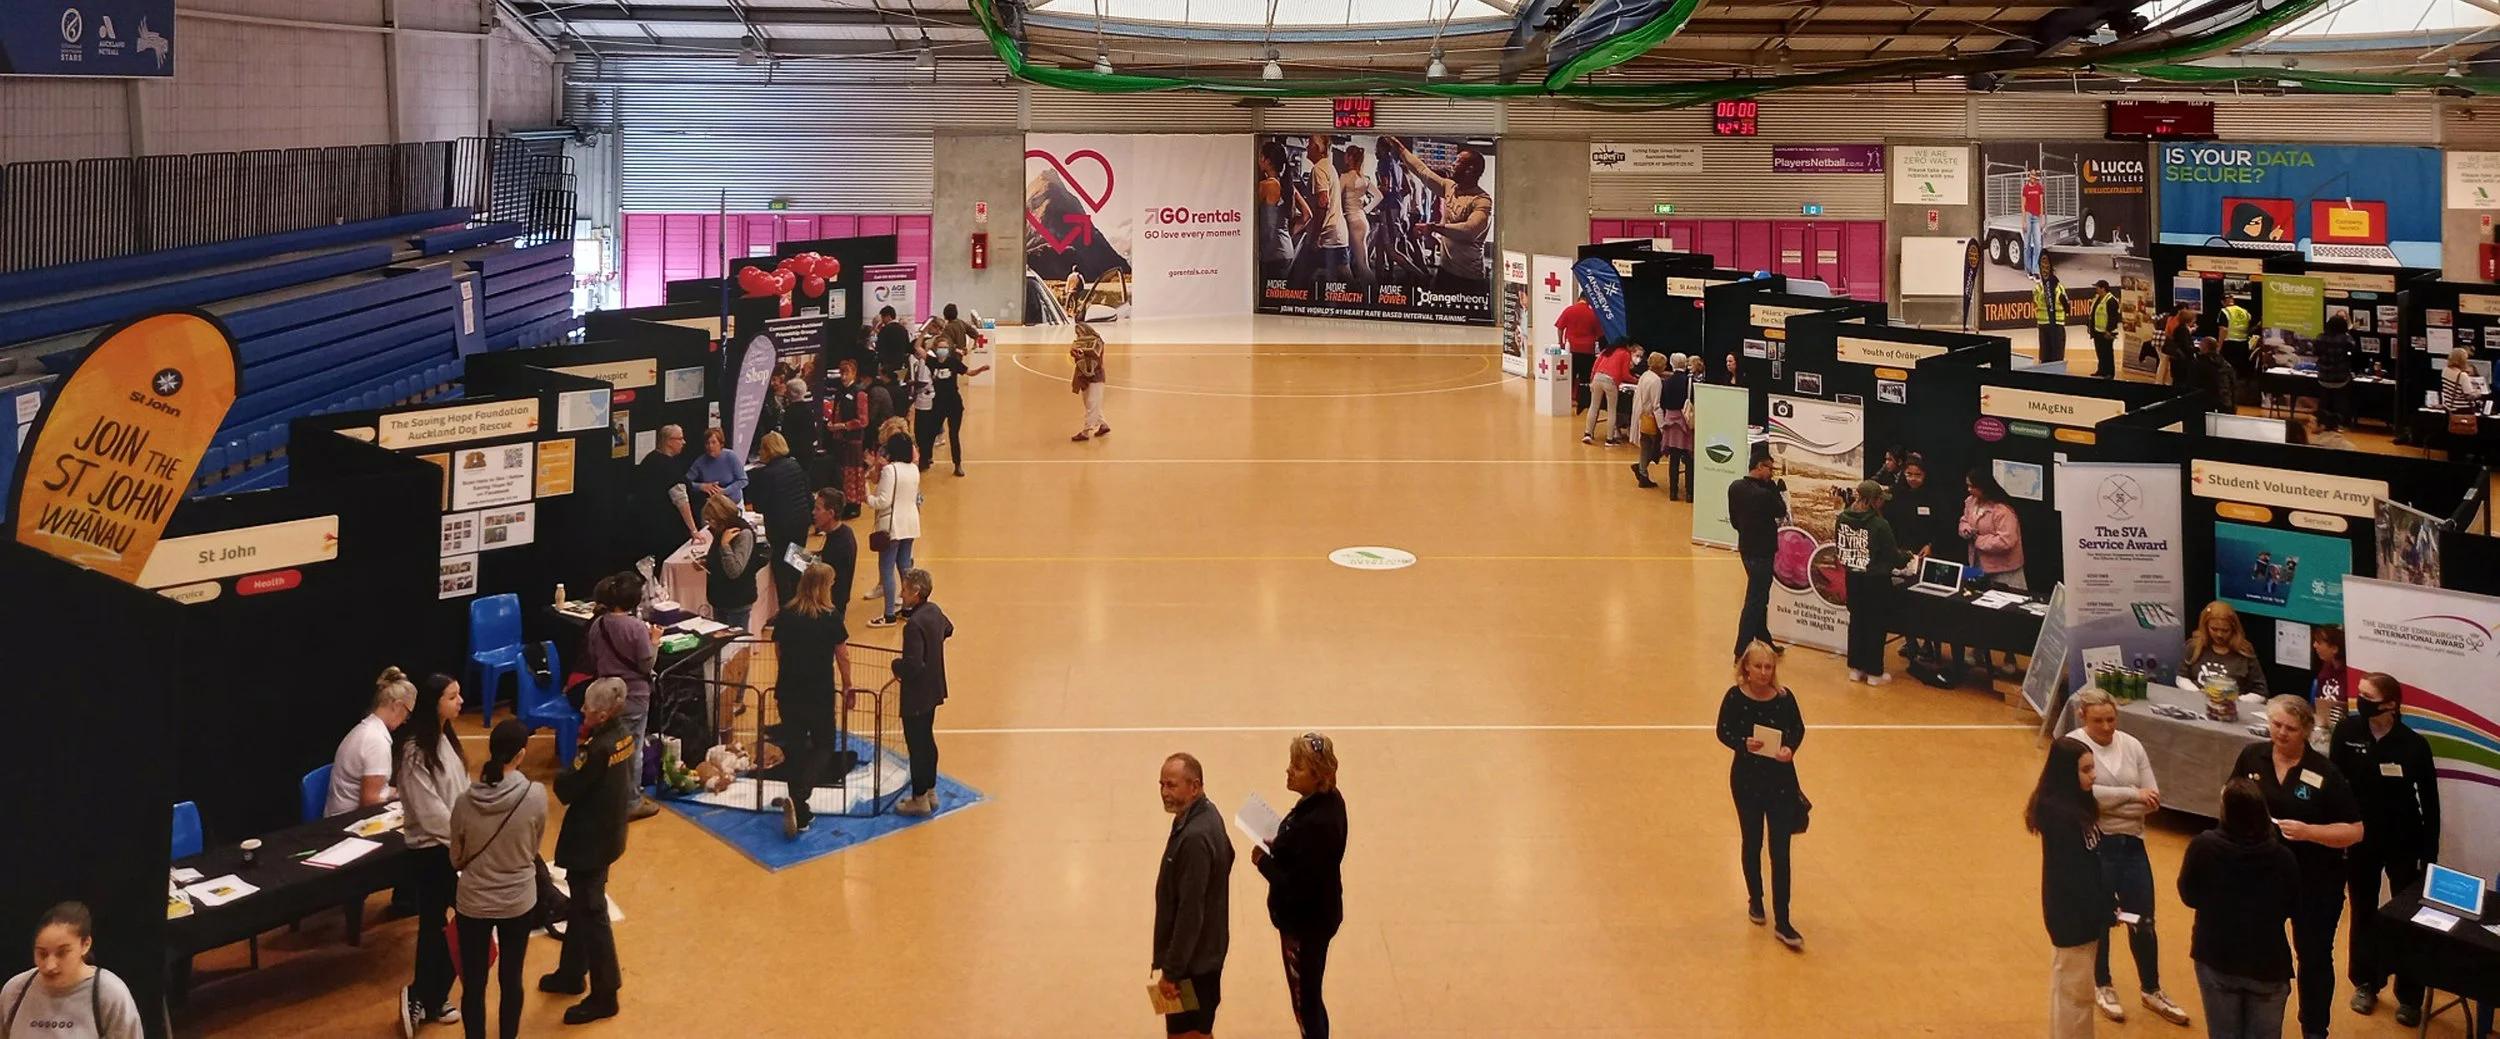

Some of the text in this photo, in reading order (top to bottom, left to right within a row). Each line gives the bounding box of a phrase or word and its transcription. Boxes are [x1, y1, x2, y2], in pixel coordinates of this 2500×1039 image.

[2165, 148, 2315, 167] IS YOUR DATA
[2100, 160, 2144, 174] LUCCA
[2102, 175, 2144, 183] TRAILERS
[2166, 166, 2265, 183] SECURE?
[1160, 207, 1241, 224] GO rentals
[1144, 229, 1240, 240] GO love every moment
[1168, 268, 1218, 278] gorentals.co.nz
[1266, 280, 1288, 290] MORE
[1324, 282, 1348, 292] MORE
[1380, 285, 1403, 295] MORE
[1265, 288, 1309, 300] ENDURANCE
[1324, 290, 1364, 302] STRENGTH
[1378, 293, 1408, 305] POWER
[1279, 305, 1294, 313] JOIN
[1306, 306, 1334, 314] WORLD'S
[1364, 310, 1382, 318] RATE
[1403, 312, 1434, 320] INTERVAL
[1435, 314, 1466, 322] TRAINING
[1862, 347, 1884, 358] Youth
[1885, 349, 1894, 360] of
[129, 391, 182, 418] St John
[390, 405, 530, 430] The Saving Hope Foundation
[408, 420, 513, 441] Auckland Dog Rescue
[74, 415, 183, 481] JOIN THE
[42, 454, 174, 525] ST JOHN
[2208, 474, 2371, 507] Student Volunteer Army
[2303, 516, 2333, 526] Service
[38, 502, 136, 554] WHĀNAU
[2094, 526, 2148, 538] The SVA
[2078, 538, 2168, 550] Service Award
[198, 545, 258, 564] St John
[253, 576, 285, 590] Health
[1776, 605, 1791, 614] Duke
[1794, 600, 1821, 612] Achieving
[2362, 619, 2376, 628] THE
[2378, 622, 2398, 630] DUKE
[2400, 624, 2410, 632] OF
[2373, 628, 2466, 650] INTERNATIONAL AWARD
